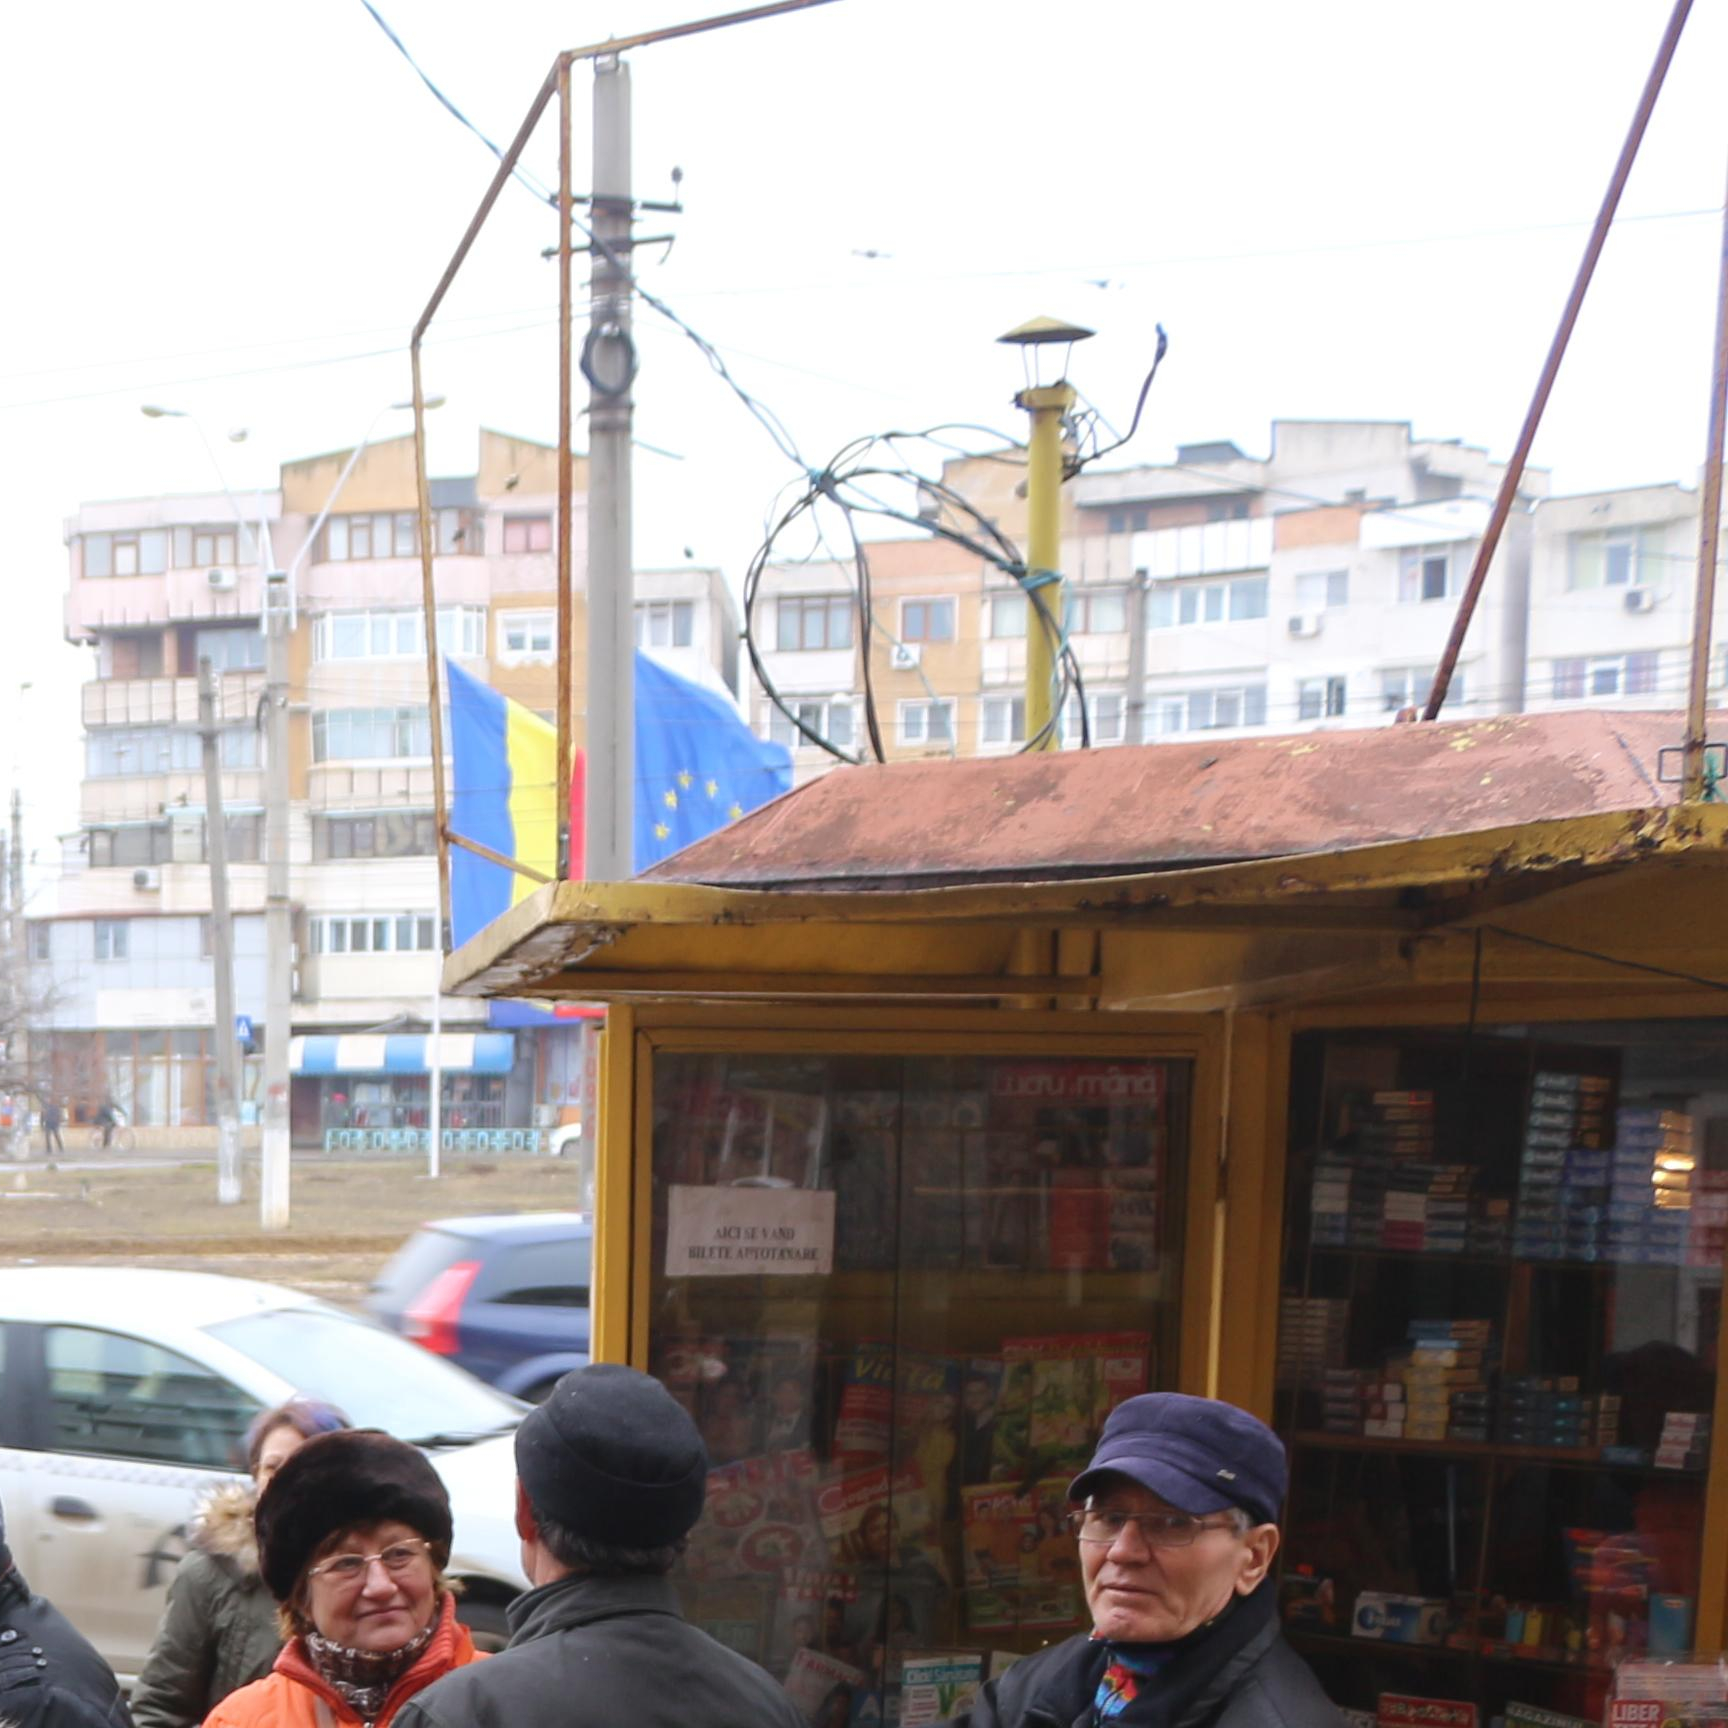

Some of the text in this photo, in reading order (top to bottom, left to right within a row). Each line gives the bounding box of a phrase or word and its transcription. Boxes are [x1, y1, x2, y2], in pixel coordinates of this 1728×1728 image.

[714, 1226, 741, 1240] AICI
[744, 1226, 757, 1240] SE
[688, 1245, 734, 1261] BILETE
[1612, 1703, 1661, 1722] LIBER
